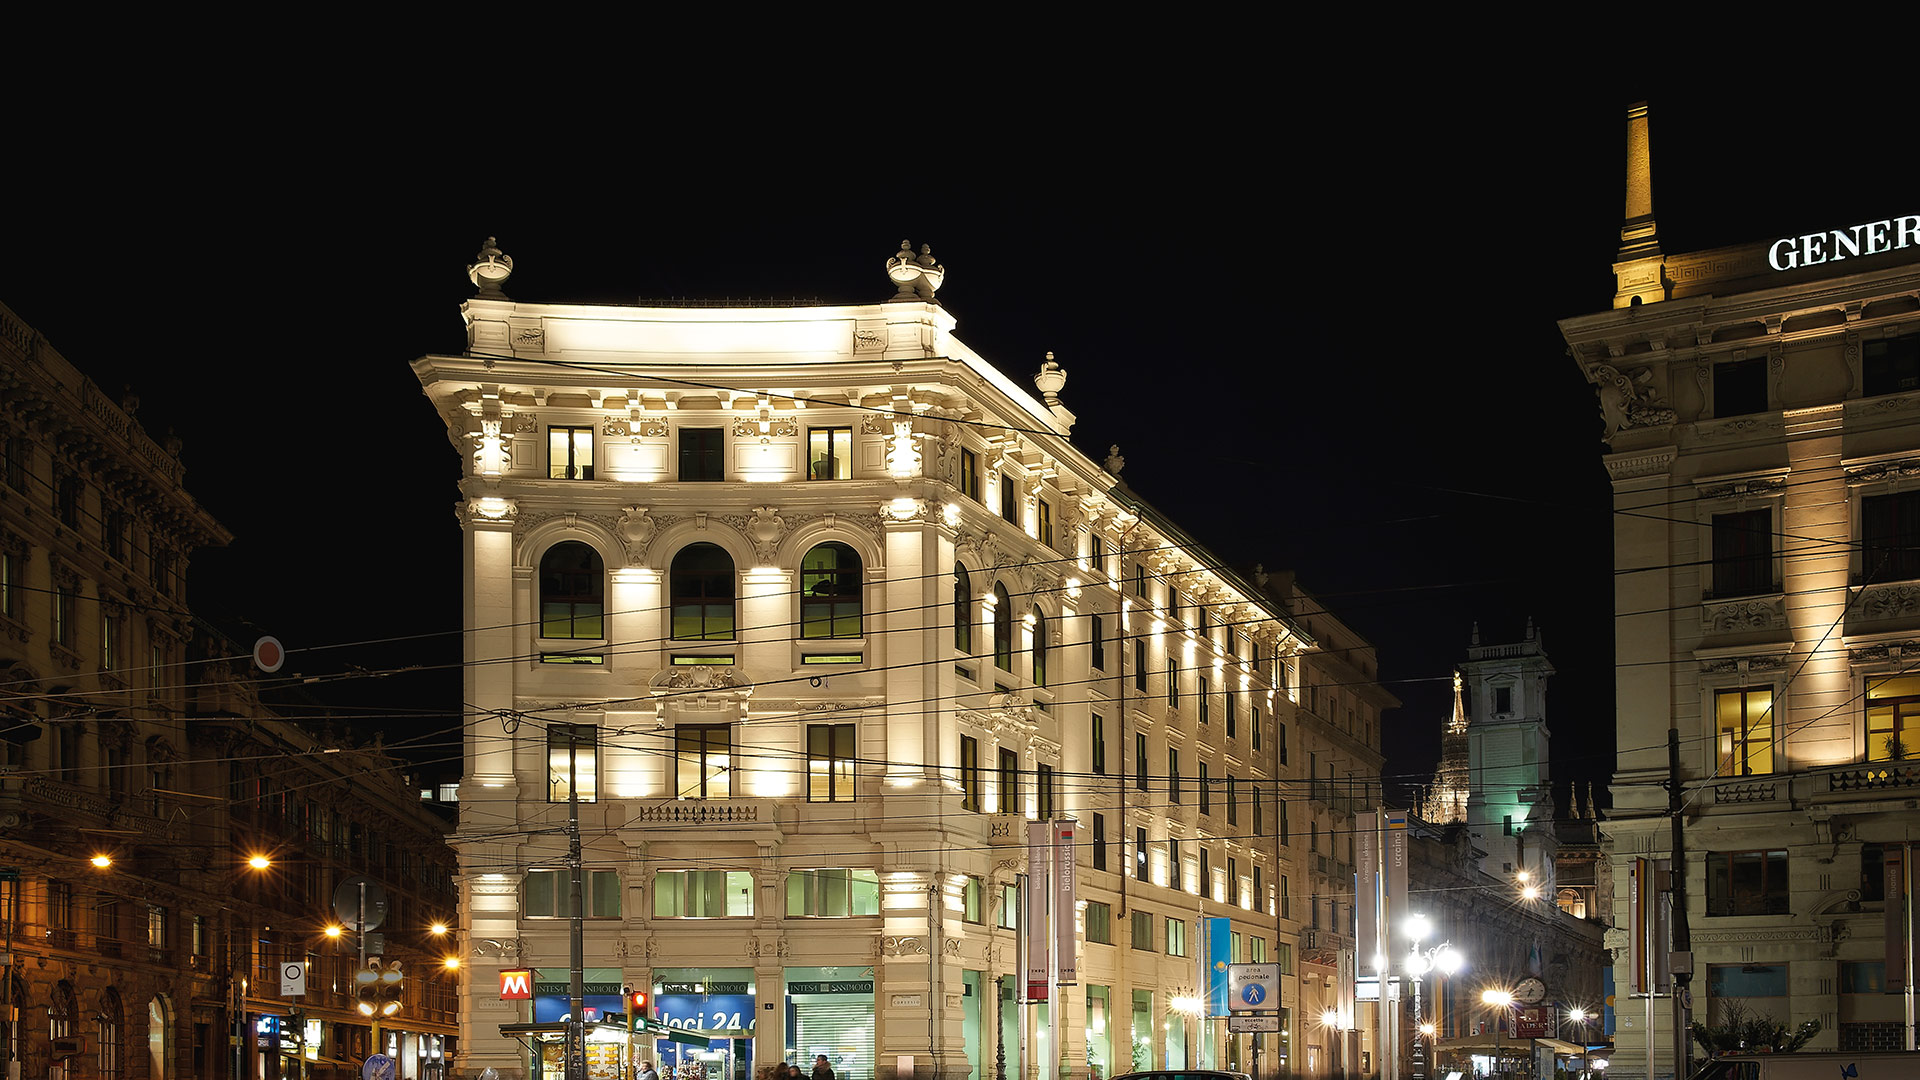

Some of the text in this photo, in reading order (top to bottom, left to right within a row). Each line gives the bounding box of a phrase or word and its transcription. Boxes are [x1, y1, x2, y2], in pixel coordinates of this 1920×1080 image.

[1768, 215, 1920, 271] GENER
[1393, 832, 1401, 867] ucraina
[1238, 973, 1270, 981] pedonale
[502, 976, 528, 994] M
[536, 985, 564, 993] INTESA
[664, 984, 693, 992] INTESA
[790, 983, 872, 992] INTESA SANPAOLO
